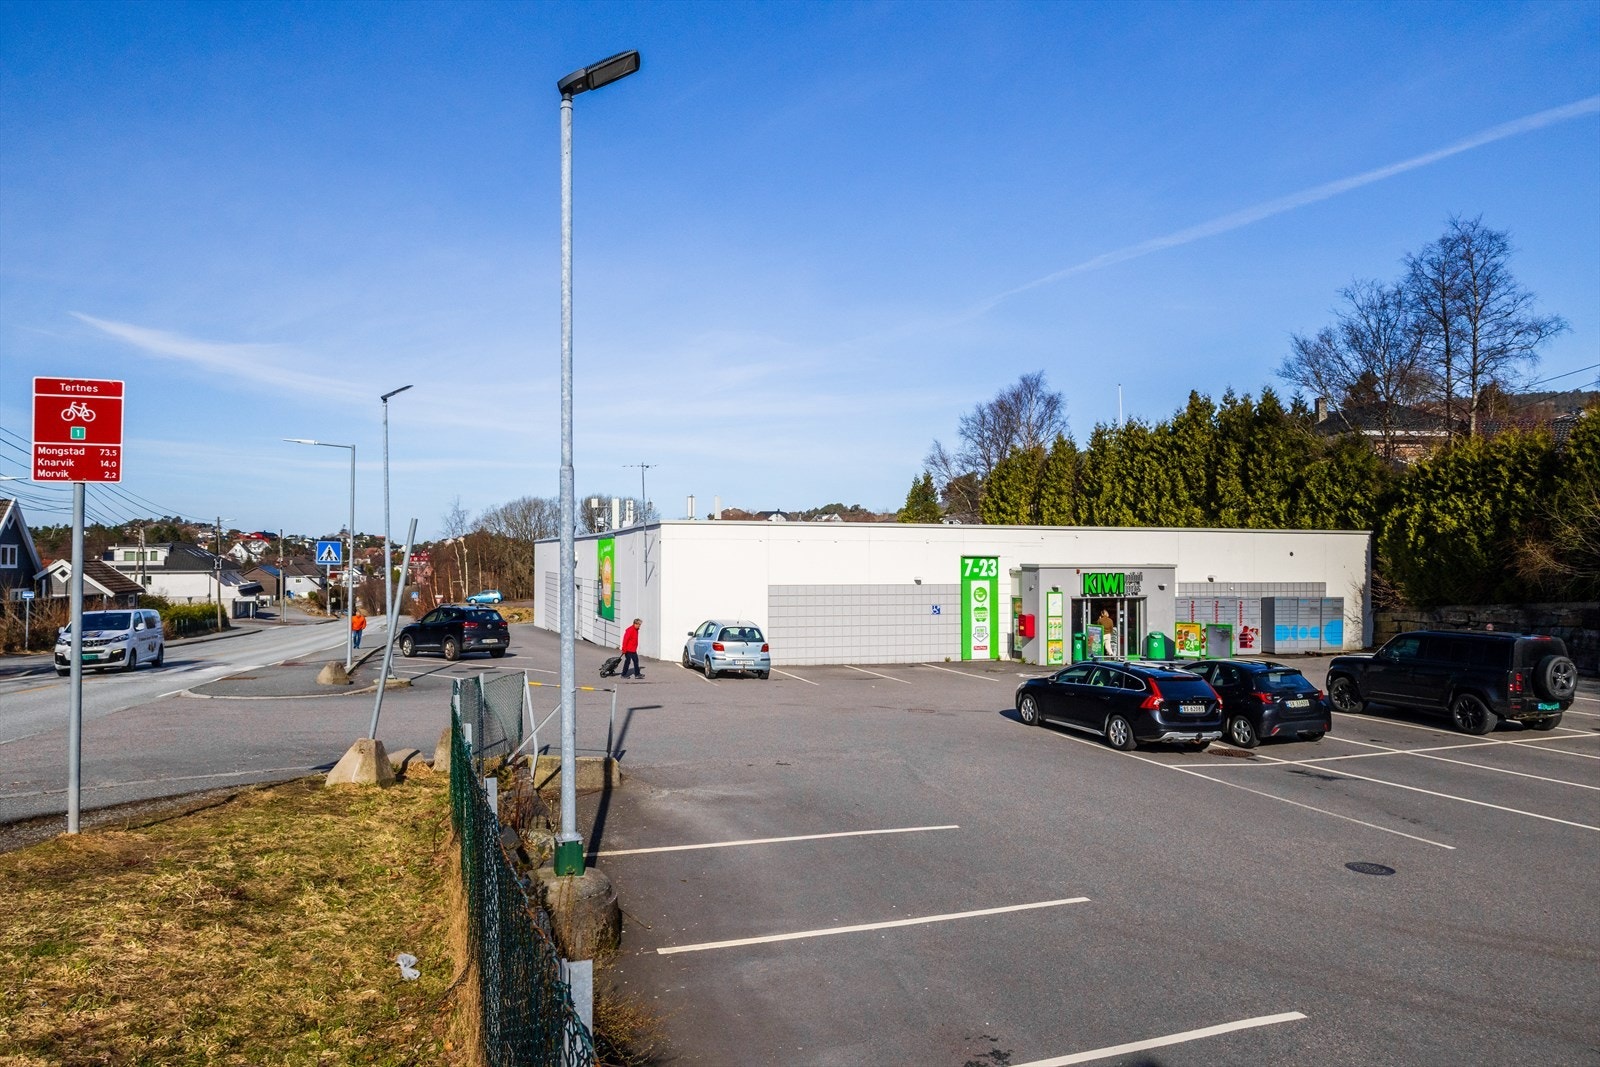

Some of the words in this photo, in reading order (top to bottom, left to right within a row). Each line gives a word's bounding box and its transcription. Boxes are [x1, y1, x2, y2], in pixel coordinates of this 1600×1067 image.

[60, 383, 98, 392] Tertnes
[38, 446, 85, 456] Mongstad
[100, 448, 117, 456] 73.5
[37, 458, 74, 467] Knarvik
[37, 470, 69, 478] Morvik
[964, 559, 997, 576] 7-23
[1083, 573, 1126, 594] KIWI
